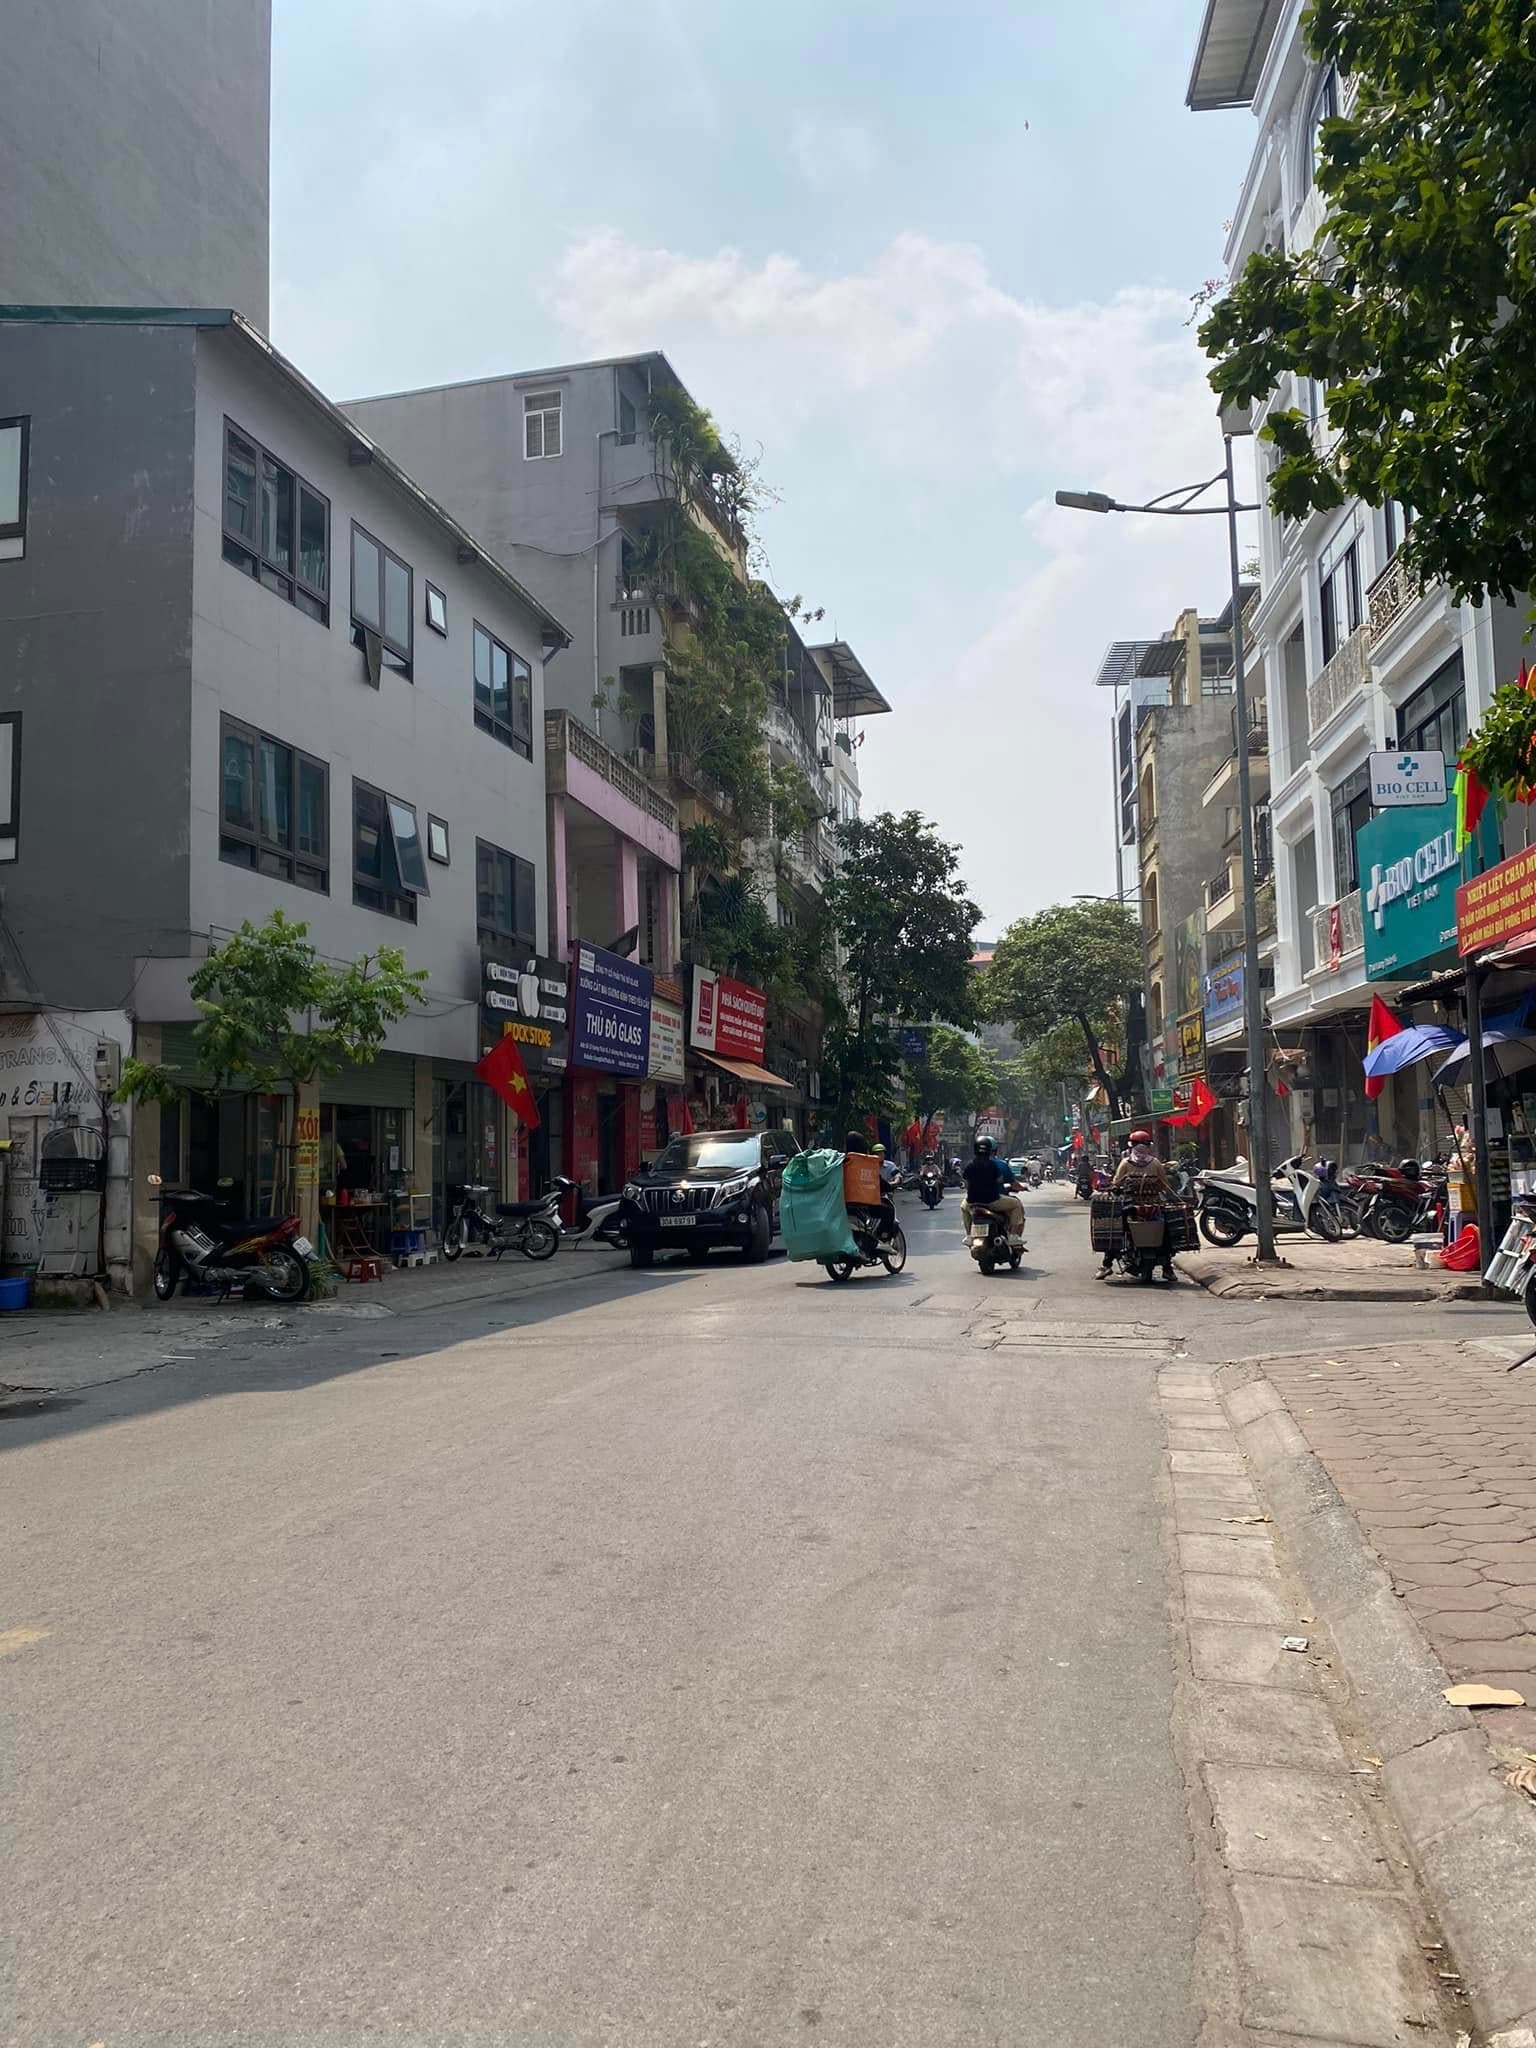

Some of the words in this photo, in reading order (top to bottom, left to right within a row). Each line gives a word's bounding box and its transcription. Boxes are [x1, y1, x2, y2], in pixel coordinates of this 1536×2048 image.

[1377, 782, 1401, 794] BIO
[1406, 781, 1443, 793] CELL
[1384, 856, 1414, 901] BIO
[1414, 829, 1459, 883] CELL
[1488, 873, 1505, 895] LIỆT
[529, 1026, 552, 1048] STORE
[586, 1009, 604, 1037] THỦ
[605, 1013, 618, 1040] ĐÔ
[618, 1022, 642, 1046] GLASS
